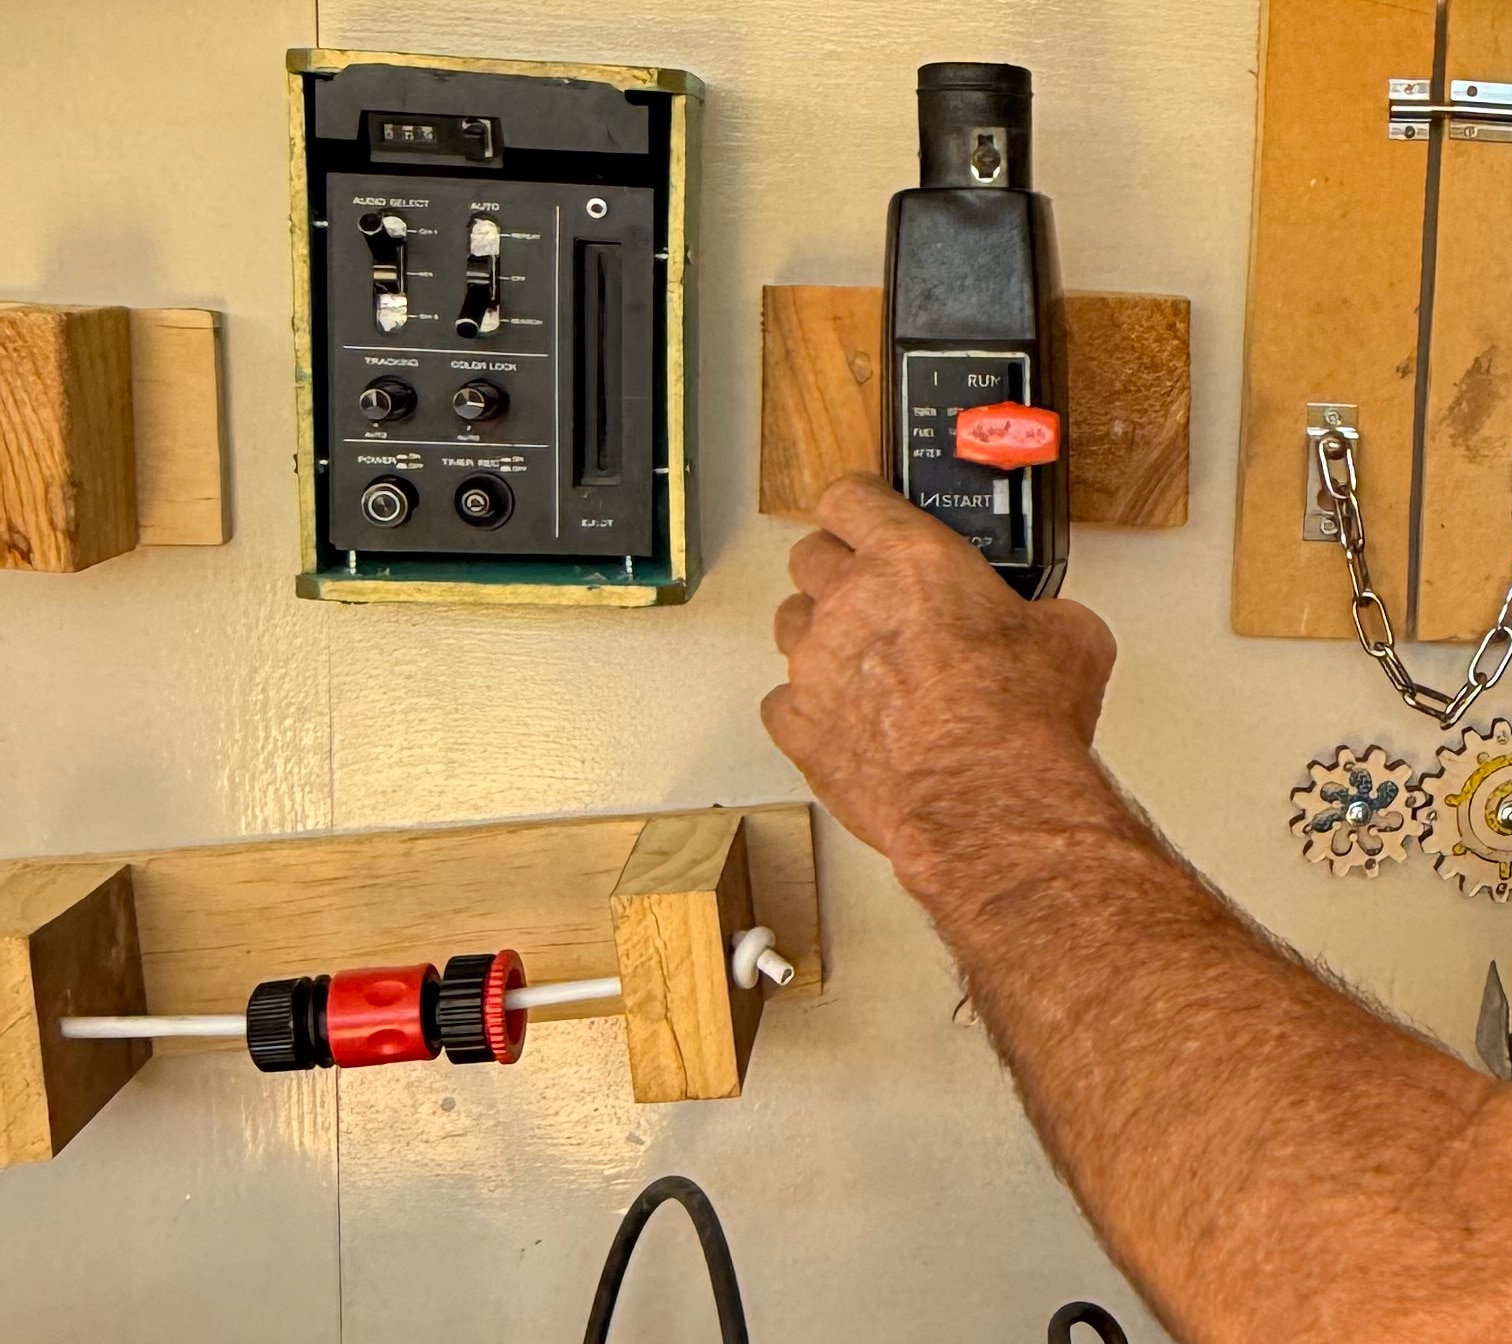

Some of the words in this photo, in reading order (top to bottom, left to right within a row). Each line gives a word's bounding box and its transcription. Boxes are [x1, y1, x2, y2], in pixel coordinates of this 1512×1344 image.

[470, 202, 499, 211] AUTO
[364, 356, 419, 367] TRACKING
[450, 360, 487, 370] COLOR
[489, 362, 517, 372] LOCK
[358, 456, 397, 465] POWER
[442, 458, 474, 467] TIMER
[942, 494, 993, 508] START
